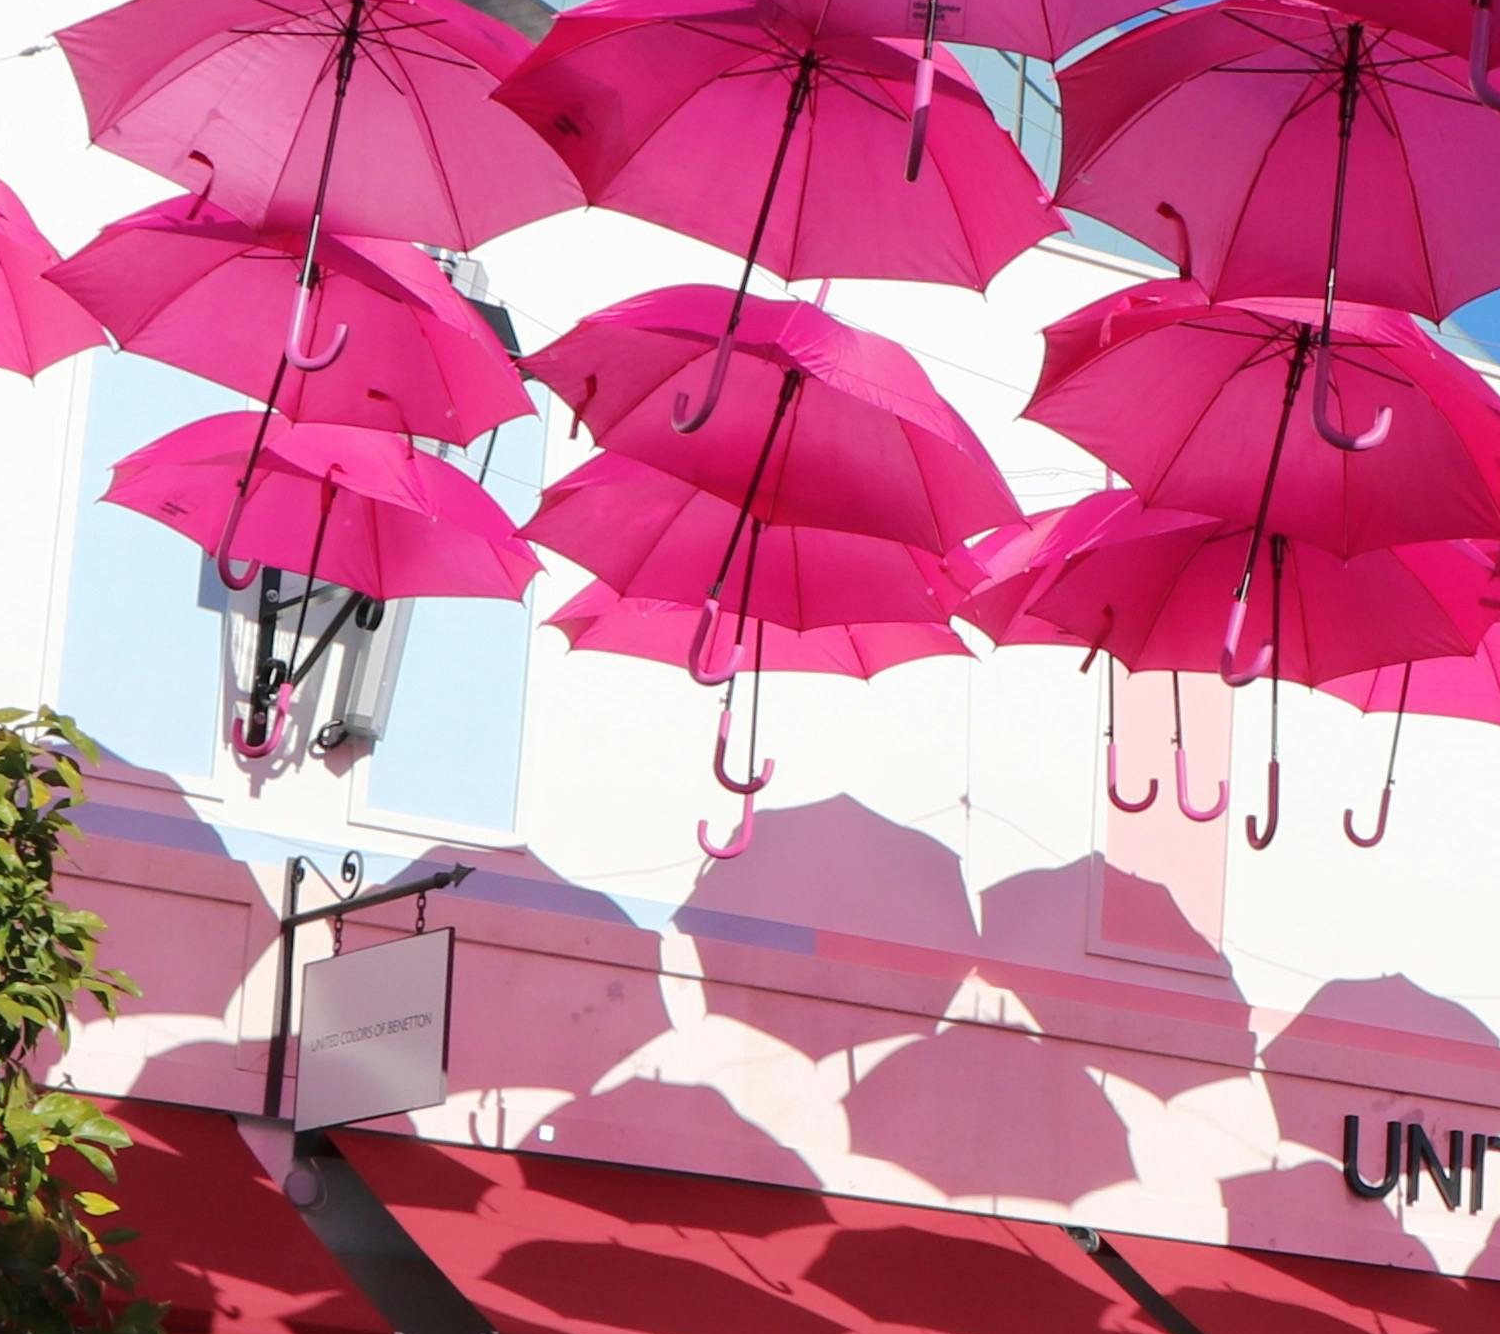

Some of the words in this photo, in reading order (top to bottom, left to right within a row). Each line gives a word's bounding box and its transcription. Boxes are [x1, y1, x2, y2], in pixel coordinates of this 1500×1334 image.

[310, 1033, 339, 1053] UNITED
[340, 1025, 373, 1046] COLORS
[373, 1022, 386, 1037] OF
[387, 1013, 433, 1035] BENETTON
